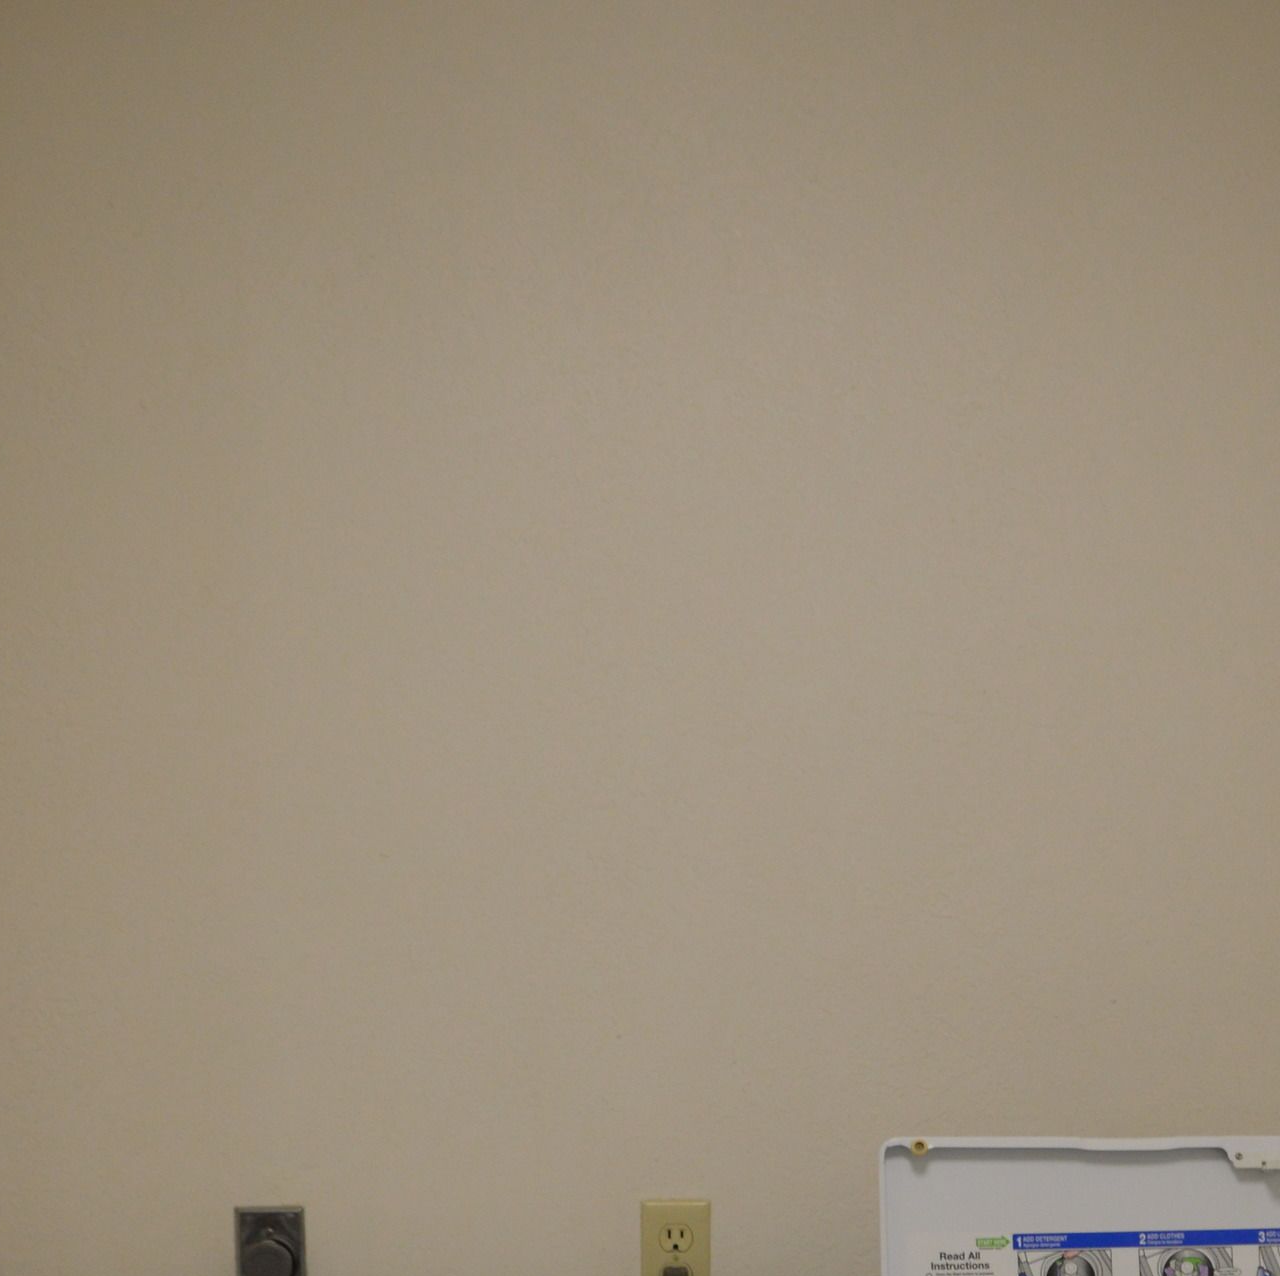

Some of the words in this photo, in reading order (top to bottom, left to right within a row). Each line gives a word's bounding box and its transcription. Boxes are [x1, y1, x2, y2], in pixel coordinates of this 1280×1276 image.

[1017, 1236, 1022, 1248] 1
[1138, 1233, 1146, 1245] 2
[1258, 1231, 1266, 1243] 3
[939, 1252, 966, 1261] Read
[968, 1252, 981, 1260] All
[930, 1262, 991, 1271] Instructions
